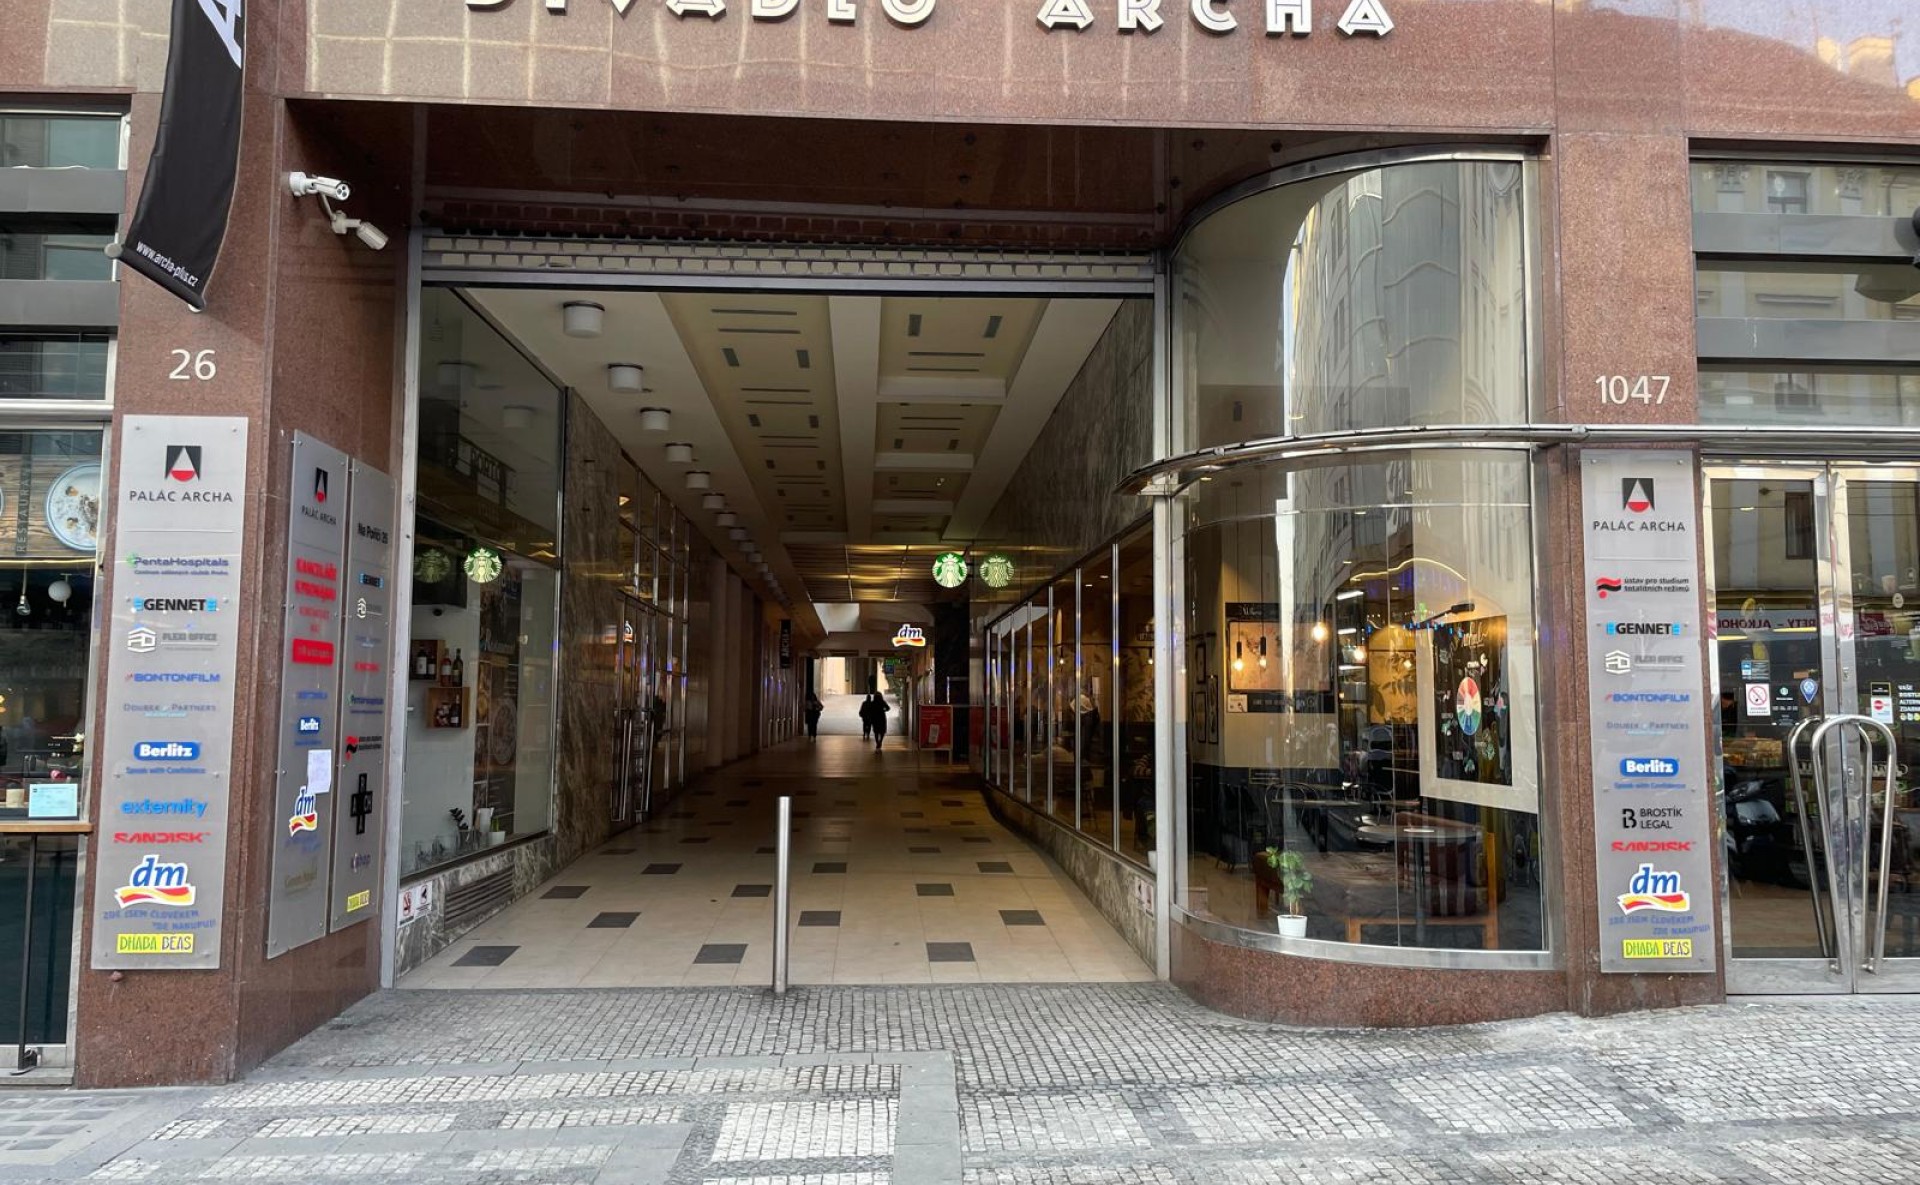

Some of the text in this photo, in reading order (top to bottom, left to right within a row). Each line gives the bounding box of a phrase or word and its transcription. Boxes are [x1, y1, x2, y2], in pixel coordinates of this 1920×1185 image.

[136, 241, 199, 287] www.archa-plus.cz
[168, 348, 217, 381] 26
[1595, 375, 1671, 405] 1047
[129, 489, 234, 502] PALÁC ARCHA
[1593, 520, 1686, 531] PALÁC ARCHA
[134, 557, 229, 568] PentaHospitals
[143, 598, 207, 611] GENNET
[899, 625, 921, 638] dm
[1615, 622, 1672, 635] GENNET
[134, 673, 220, 682] BONTONFILM
[1613, 693, 1690, 702] BONTONFILM
[140, 743, 193, 757] Berlitz
[1626, 759, 1674, 773] Berlitz
[121, 798, 209, 818] externity
[296, 788, 316, 816] dm
[1640, 805, 1683, 817] BROSTÍK
[1640, 820, 1674, 829] LEGAL
[113, 832, 203, 843] SANDISK
[1611, 841, 1691, 851] SANDISK
[132, 857, 185, 887] dm
[1632, 867, 1678, 893] dm
[119, 935, 193, 951] DHABA BEAS
[1625, 941, 1690, 956] DHABA BEAS
